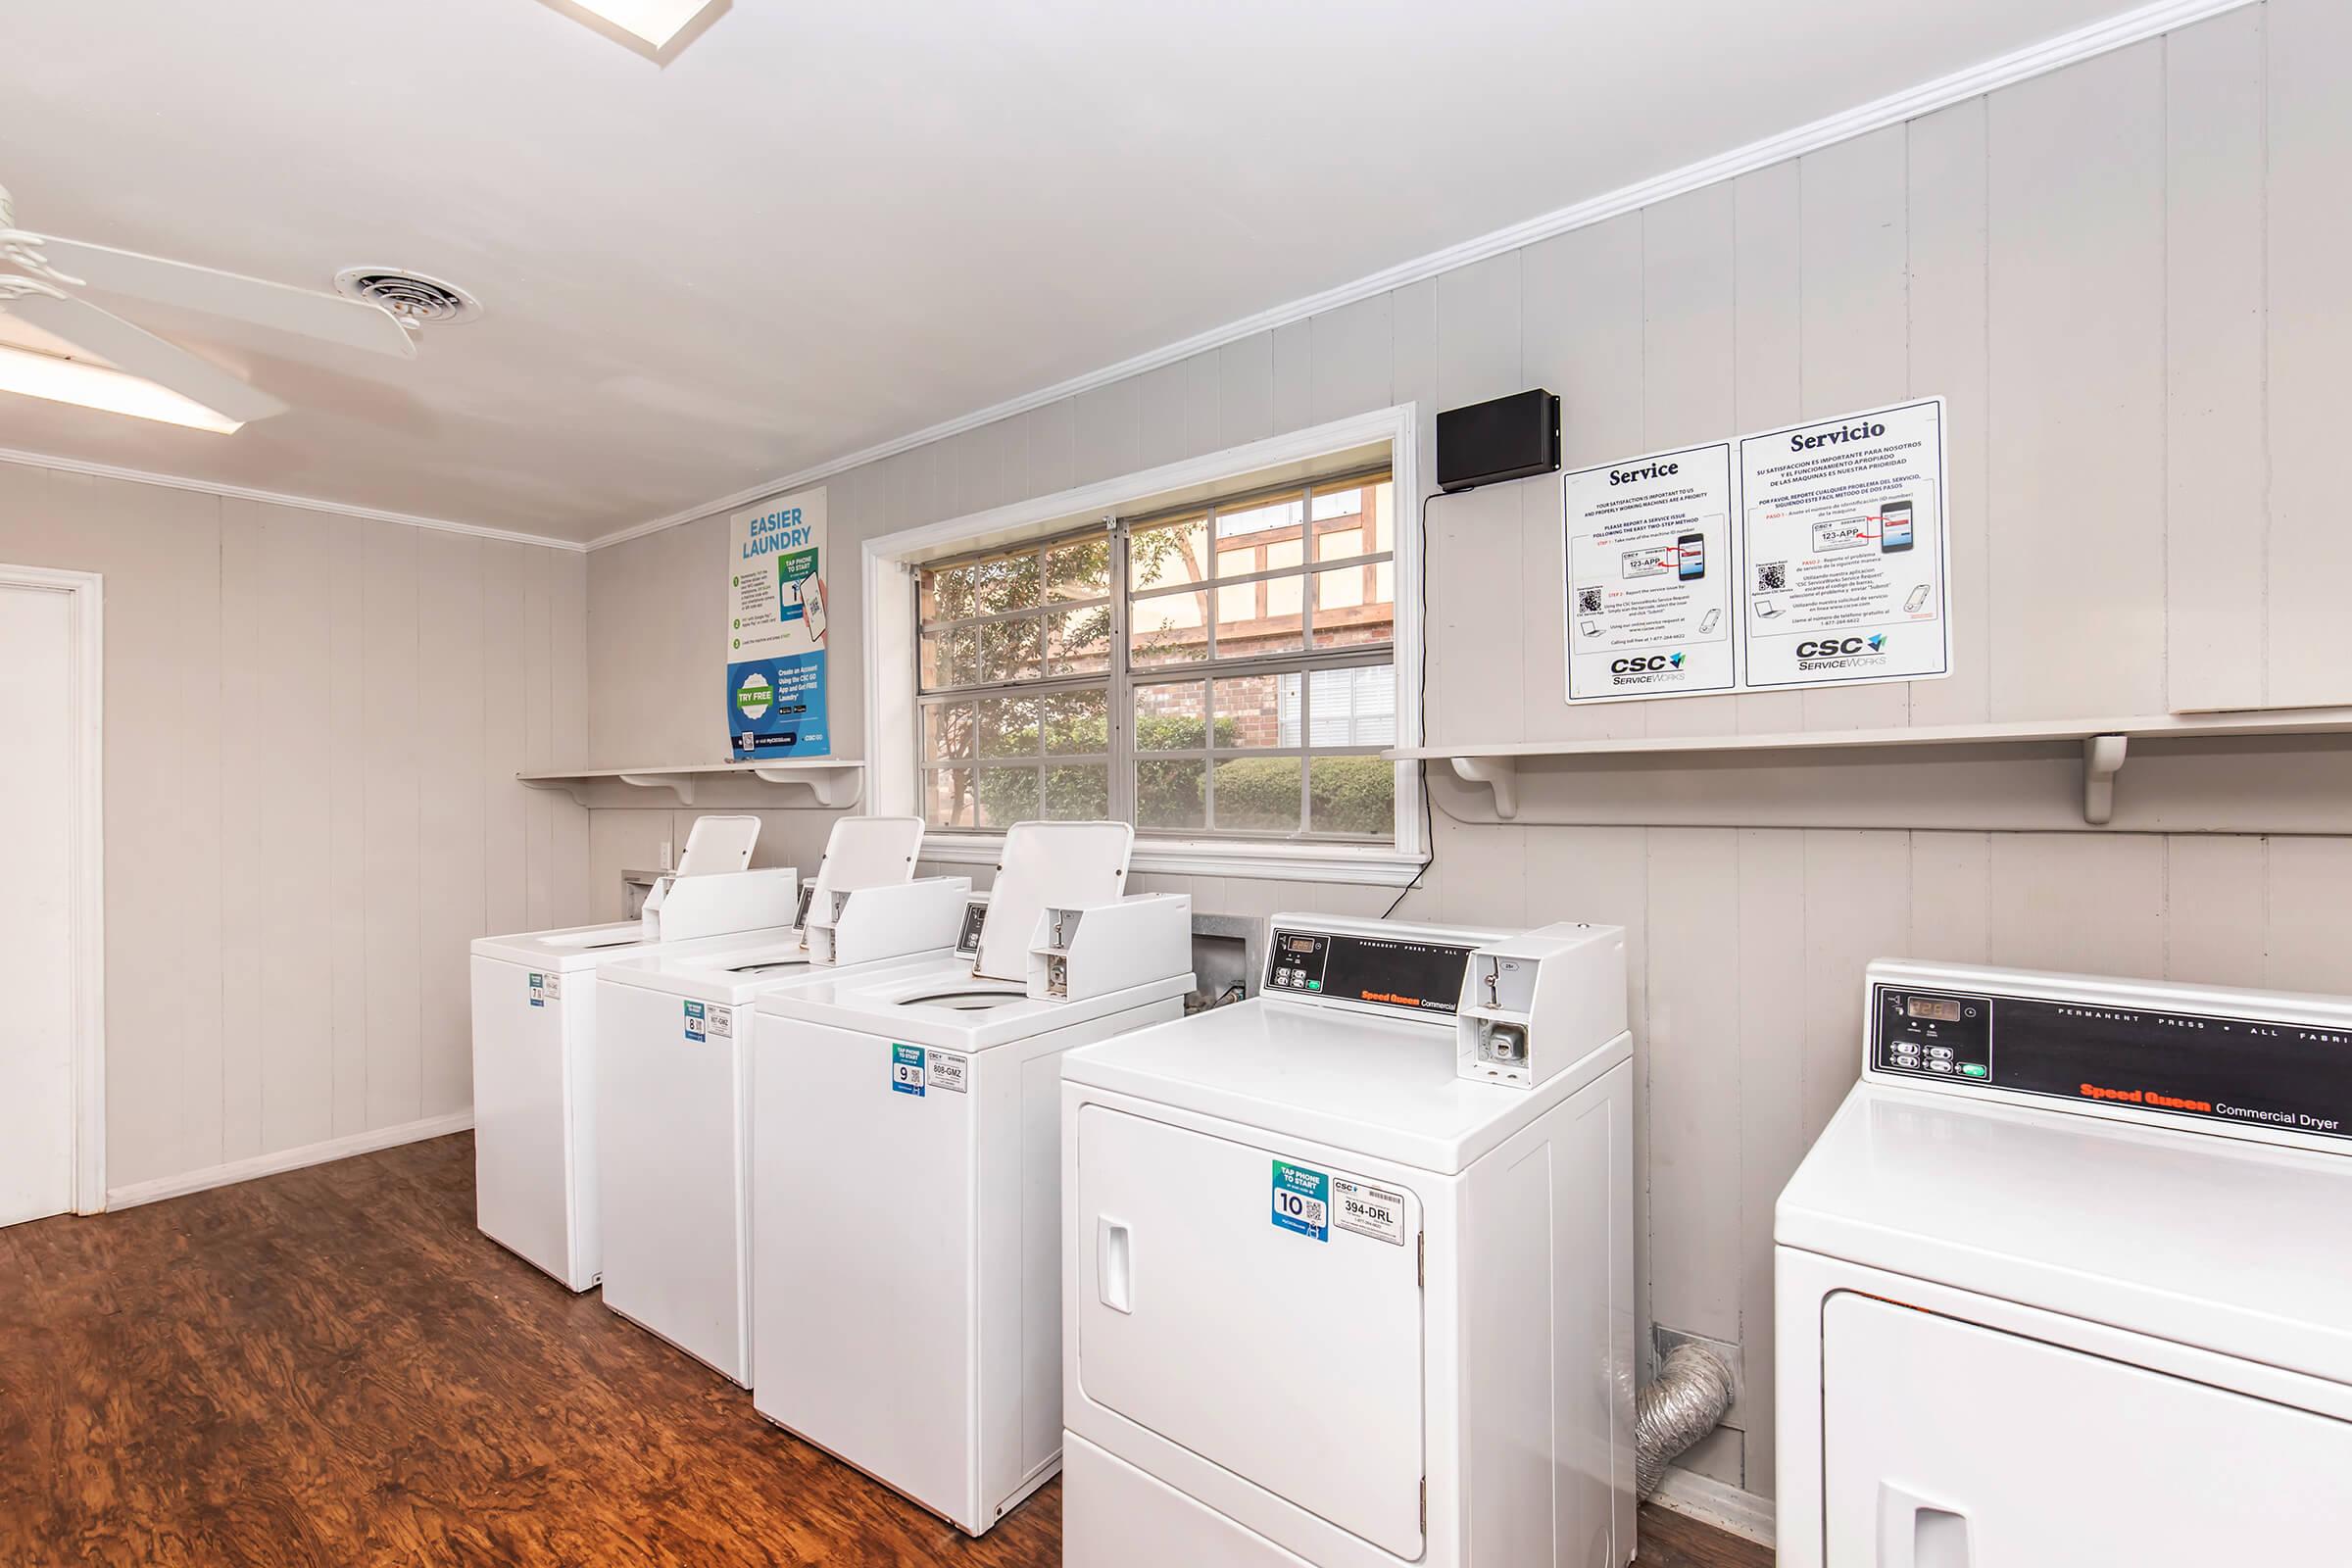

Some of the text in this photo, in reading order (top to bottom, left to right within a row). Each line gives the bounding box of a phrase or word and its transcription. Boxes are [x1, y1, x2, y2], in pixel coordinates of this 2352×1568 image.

[1790, 421, 1885, 453] Servicio
[1821, 452, 1862, 465] IMPORTANTE
[1864, 448, 1882, 457] PARA
[1884, 441, 1921, 453] NOSOTROS
[1792, 472, 1827, 483] MAQUINAS
[1838, 466, 1867, 475] NUESTRA
[1869, 459, 1906, 469] PRIORIDAD
[1794, 461, 1853, 475] FUNCIONAMIENTO
[1854, 454, 1894, 466] APROPIADO
[1609, 463, 1678, 486] Service
[1815, 486, 1846, 496] CUALQUIER
[1848, 481, 1879, 491] PROBLEMA
[1610, 497, 1642, 507] SATISFACTION
[1649, 491, 1678, 500] IMPORTANT
[1775, 500, 1804, 509] SIGUIENDO
[750, 508, 802, 537] EASIER
[743, 525, 811, 559] LAUNDRY
[1593, 529, 1622, 538] FOLLOWING
[1823, 529, 1858, 540] 123-APP
[796, 556, 811, 564] PHONE
[1631, 559, 1660, 567] 123-APP
[1796, 638, 1863, 658] CSC
[1611, 656, 1666, 674] CSC
[739, 691, 771, 702] TRY FREE
[1359, 941, 1397, 950] PERMANENT
[1361, 990, 1456, 1010] Speed Queen Commercial
[690, 1019, 694, 1030] 8
[2058, 1007, 2139, 1021] PERMANENT
[2158, 1018, 2205, 1029] PRESS
[2250, 1028, 2278, 1037] ALL
[901, 1067, 907, 1081] 9
[2080, 1083, 2338, 1130] Speed Queen Commercial Dryer
[1281, 1167, 1320, 1184] TAP PHONE
[1295, 1176, 1317, 1190] START
[1336, 1182, 1352, 1192] CSC
[1280, 1193, 1302, 1215] 10
[1345, 1200, 1393, 1223] 394-DRL
